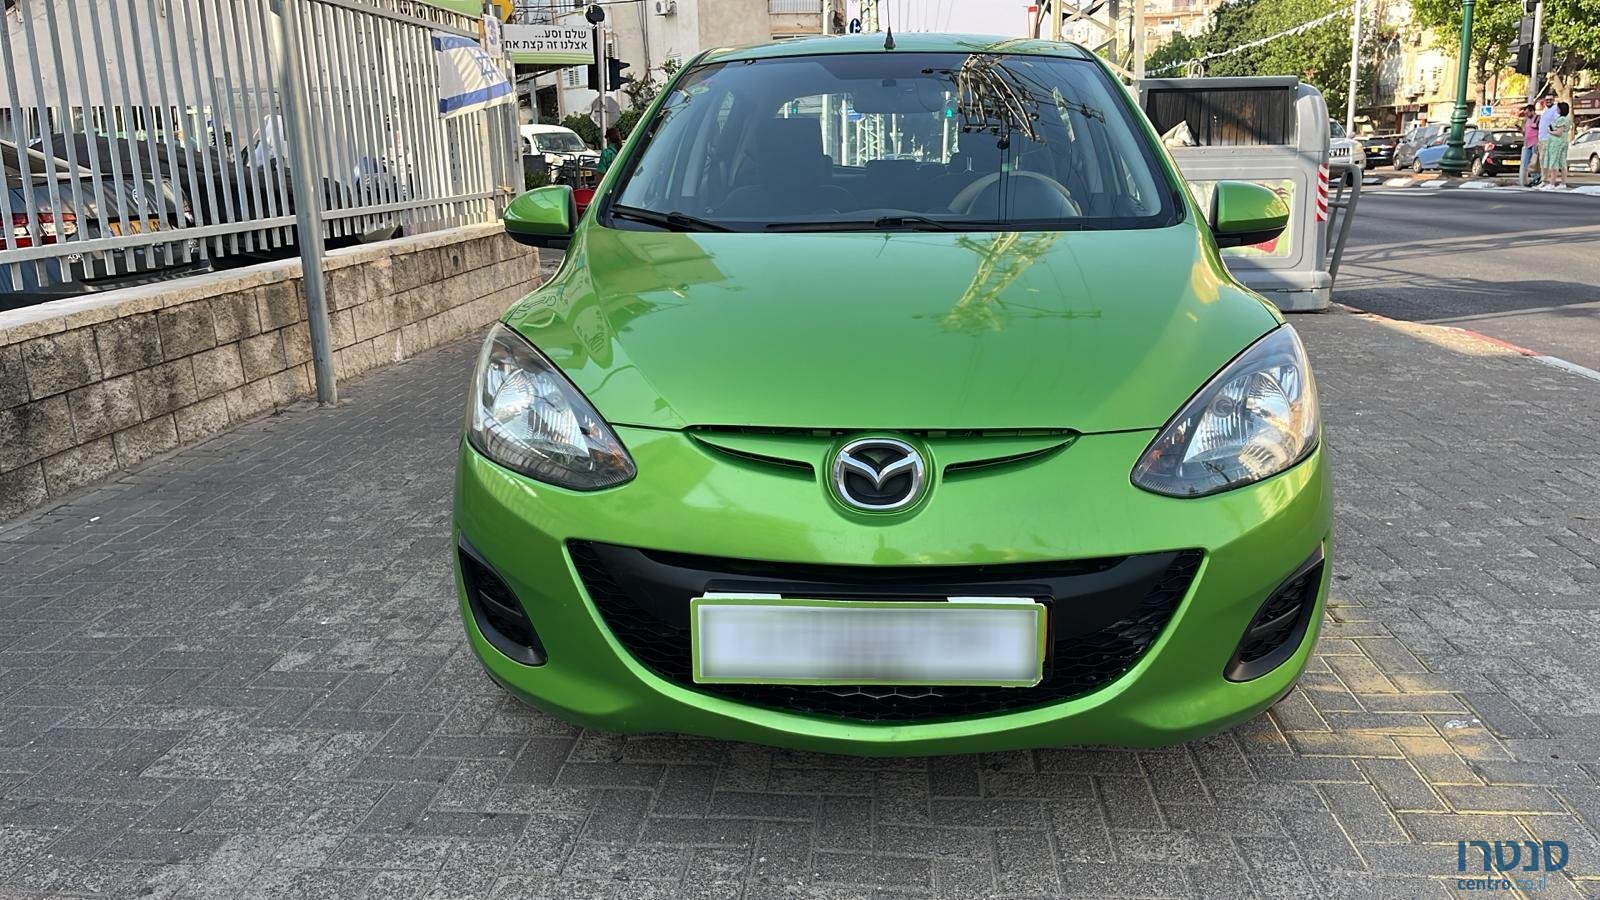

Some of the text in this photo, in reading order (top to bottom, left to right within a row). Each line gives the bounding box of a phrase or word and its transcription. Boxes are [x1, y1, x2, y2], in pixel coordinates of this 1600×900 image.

[565, 29, 586, 39] שלם
[505, 40, 587, 51] אצלנו זה קצת אח
